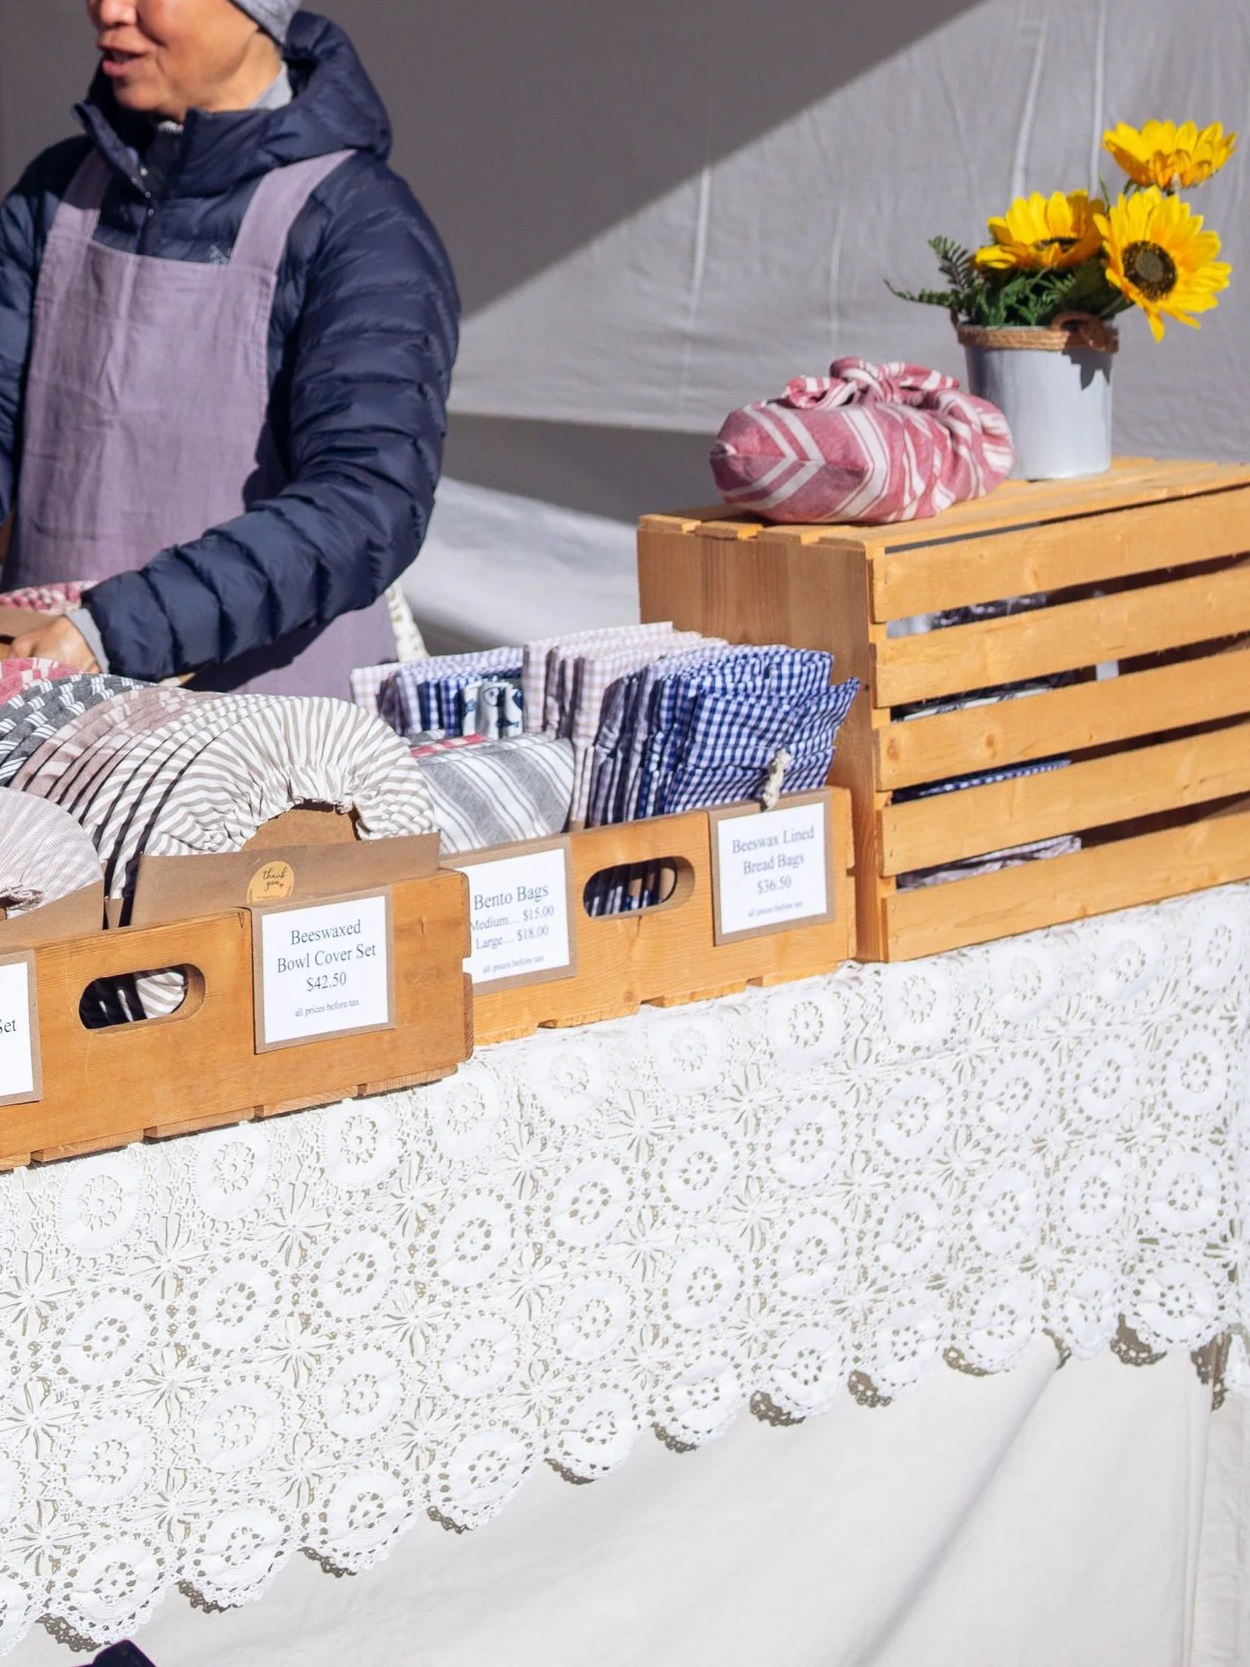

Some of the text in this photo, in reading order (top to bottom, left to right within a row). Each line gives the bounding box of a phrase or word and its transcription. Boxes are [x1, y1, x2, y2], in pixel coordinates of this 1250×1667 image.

[732, 824, 815, 855] Beeswax Lined
[262, 865, 288, 881] thank
[743, 853, 805, 876] Bread Bags
[756, 875, 792, 895] $36.50
[473, 885, 550, 911] Bento Bags
[522, 904, 555, 922] $15.00
[290, 918, 362, 946] Beeswaxed
[516, 924, 550, 942] $18.00
[277, 942, 377, 974] Bowl Cover Set
[306, 970, 347, 992] $42.50
[294, 998, 361, 1018] all prices before tax
